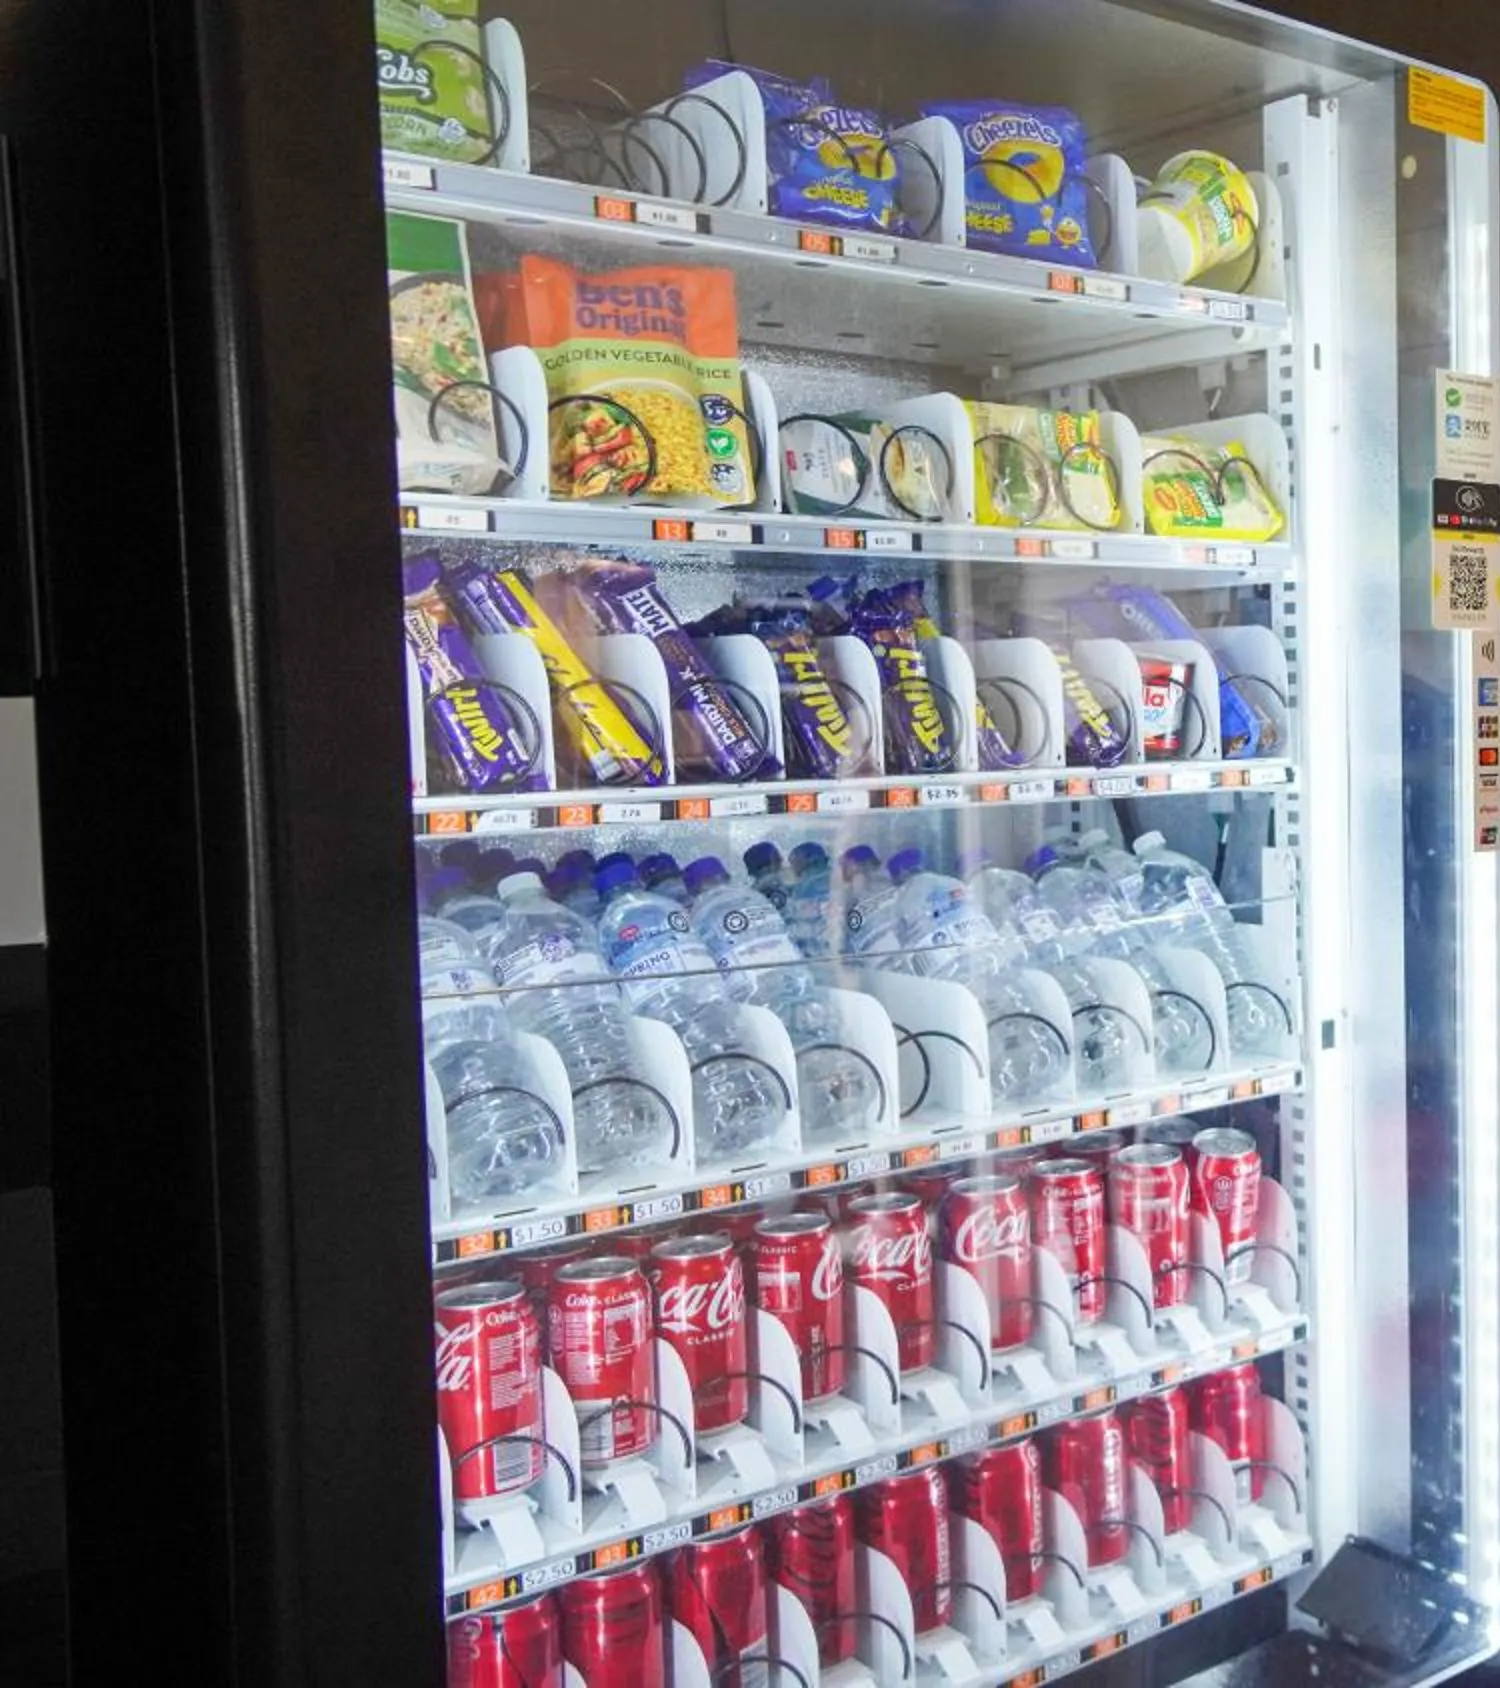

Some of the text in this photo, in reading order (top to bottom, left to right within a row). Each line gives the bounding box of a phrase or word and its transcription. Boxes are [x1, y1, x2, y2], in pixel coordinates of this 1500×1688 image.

[965, 118, 1062, 154] Cheezels
[604, 200, 626, 218] 03
[966, 211, 1012, 234] HEESE
[545, 349, 606, 371] GOLDEN
[697, 366, 732, 380] RICE
[662, 523, 683, 539] 13
[833, 531, 851, 547] 15
[625, 590, 670, 633] MATE
[784, 651, 854, 758] Twirl
[889, 647, 945, 754] Twirl
[444, 687, 504, 763] Twirl
[702, 700, 738, 745] DAIRY
[437, 812, 460, 831] 22
[569, 808, 589, 824] 23
[683, 799, 705, 817] 24
[636, 1196, 681, 1220] $1.50
[705, 1186, 728, 1203] 34
[465, 1220, 563, 1253] 32 $1.50
[486, 1310, 522, 1327] Coke
[713, 1488, 797, 1527] 44 $2.50
[597, 1526, 690, 1566] 43 $2.50
[472, 1563, 573, 1603] 42 $2.50
